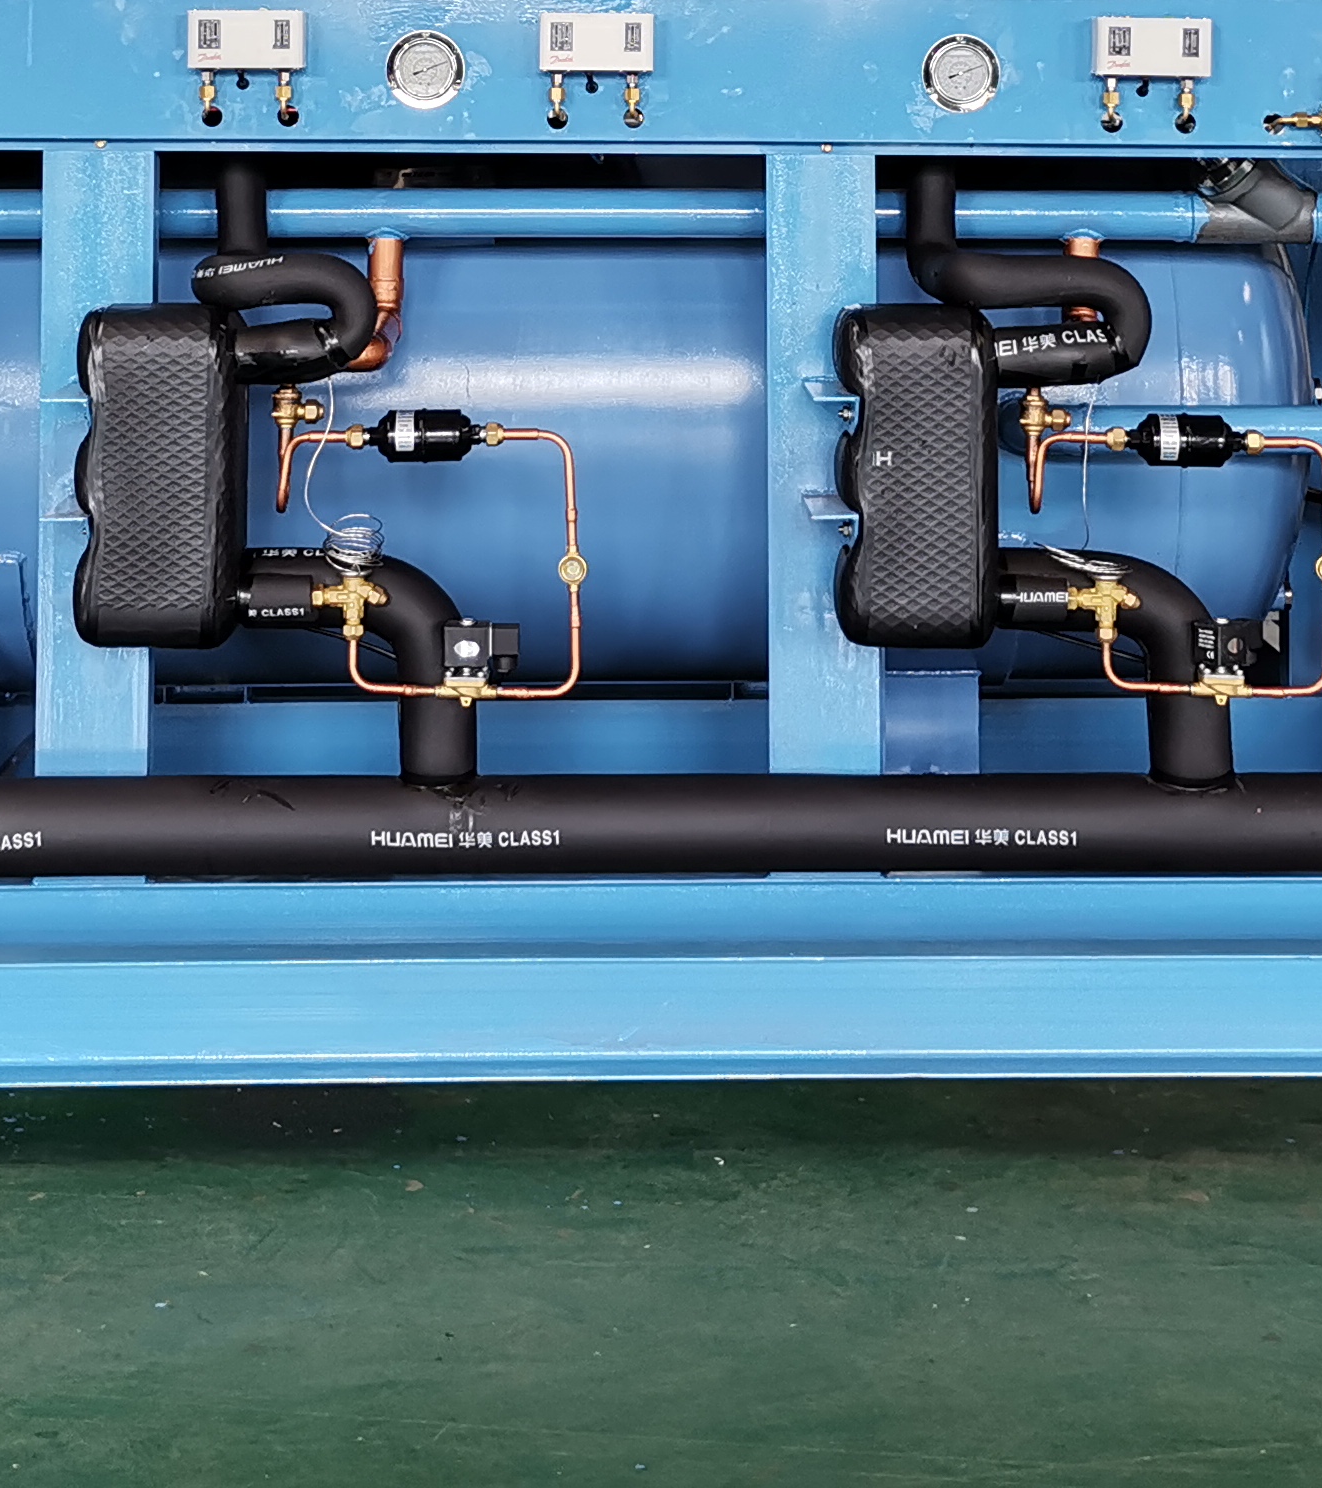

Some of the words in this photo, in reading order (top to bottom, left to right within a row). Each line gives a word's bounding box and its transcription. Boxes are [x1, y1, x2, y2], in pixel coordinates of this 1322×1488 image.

[218, 256, 284, 276] HUAMEI
[1022, 333, 1057, 353] 华美
[261, 608, 305, 617] CLASS1
[371, 830, 454, 848] HUAMEI
[458, 831, 493, 849] 华美
[498, 829, 560, 847] CLASS1
[886, 828, 970, 846] HUAMEI
[974, 828, 1010, 846] 华美
[1014, 829, 1078, 846] CLASS1
